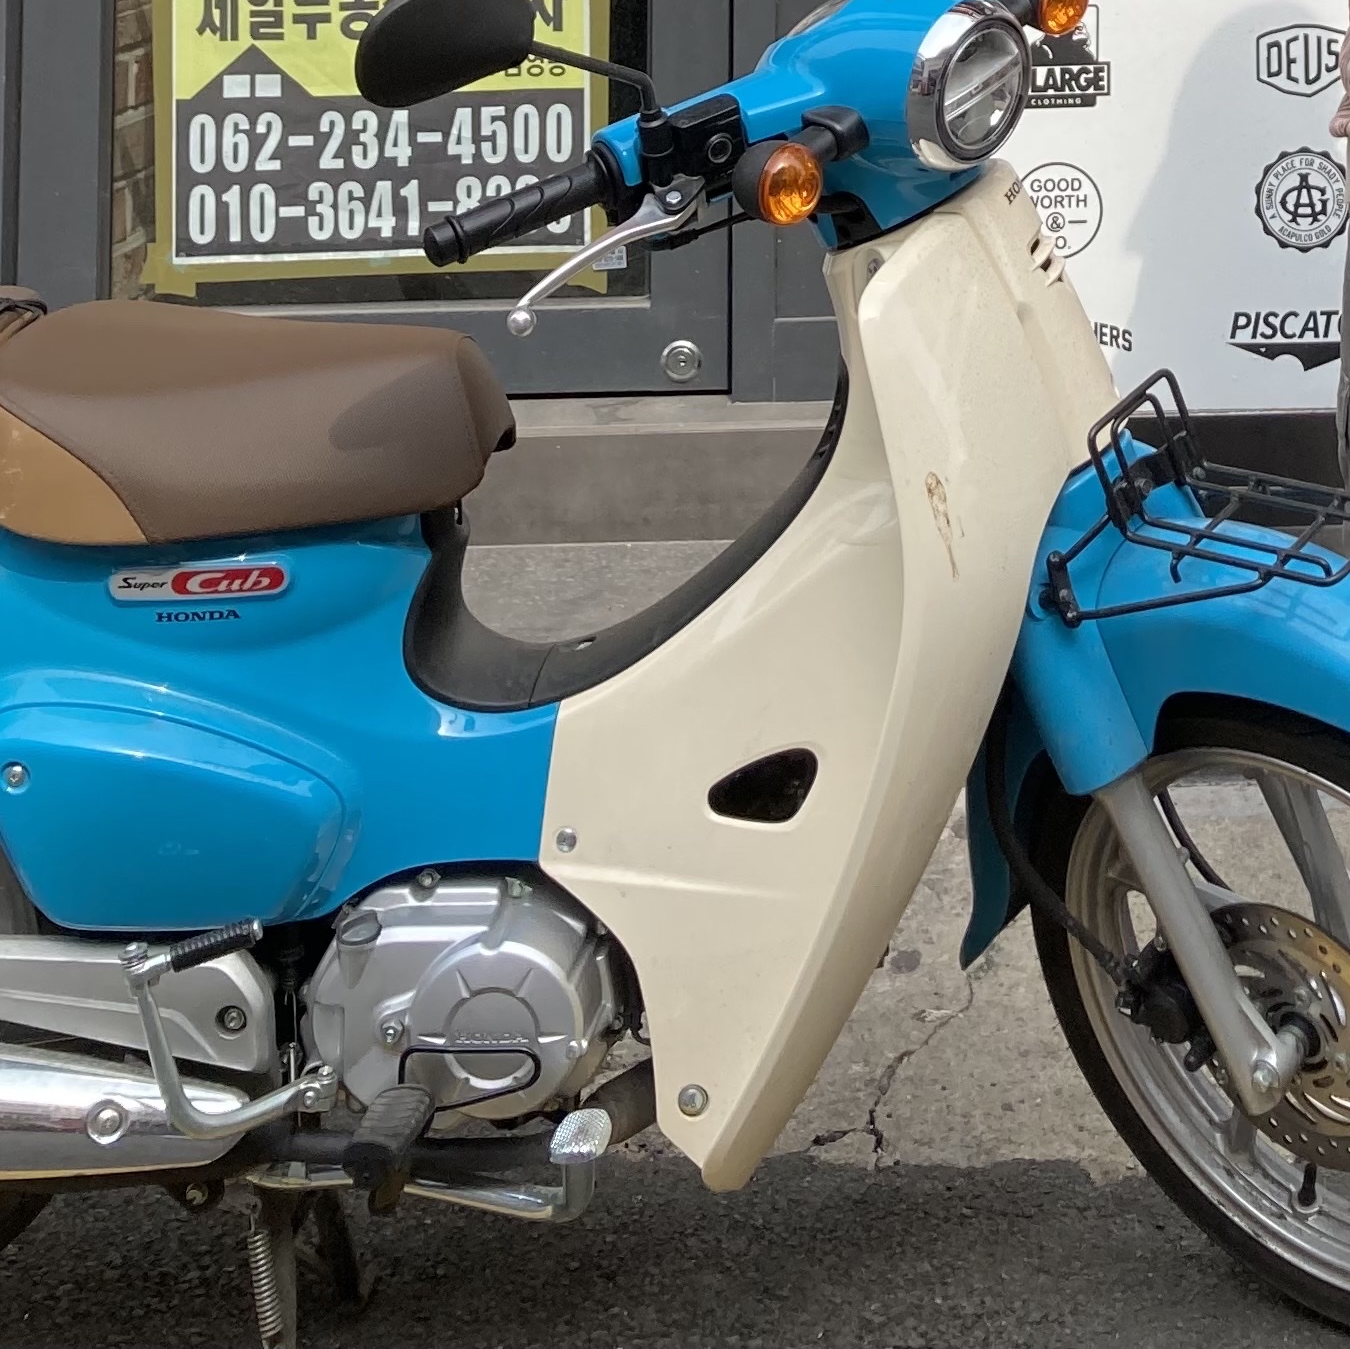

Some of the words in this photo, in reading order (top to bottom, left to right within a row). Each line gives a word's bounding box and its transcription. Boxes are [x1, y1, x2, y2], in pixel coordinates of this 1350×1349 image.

[1266, 33, 1340, 85] DEUS
[1031, 97, 1082, 106] CLOTHING
[188, 103, 573, 174] 062-234-4500
[1030, 177, 1082, 193] GOOD
[1273, 159, 1296, 181] PLACE
[1299, 157, 1315, 167] FOR
[1317, 161, 1341, 184] SHADY
[1332, 187, 1345, 220] PEOPLE
[1278, 225, 1313, 243] ACAPULCO
[1314, 224, 1332, 240] GOLD
[1230, 310, 1342, 340] PISCAT
[118, 576, 168, 592] Super
[186, 569, 272, 594] Cub
[155, 609, 241, 623] HONDA
